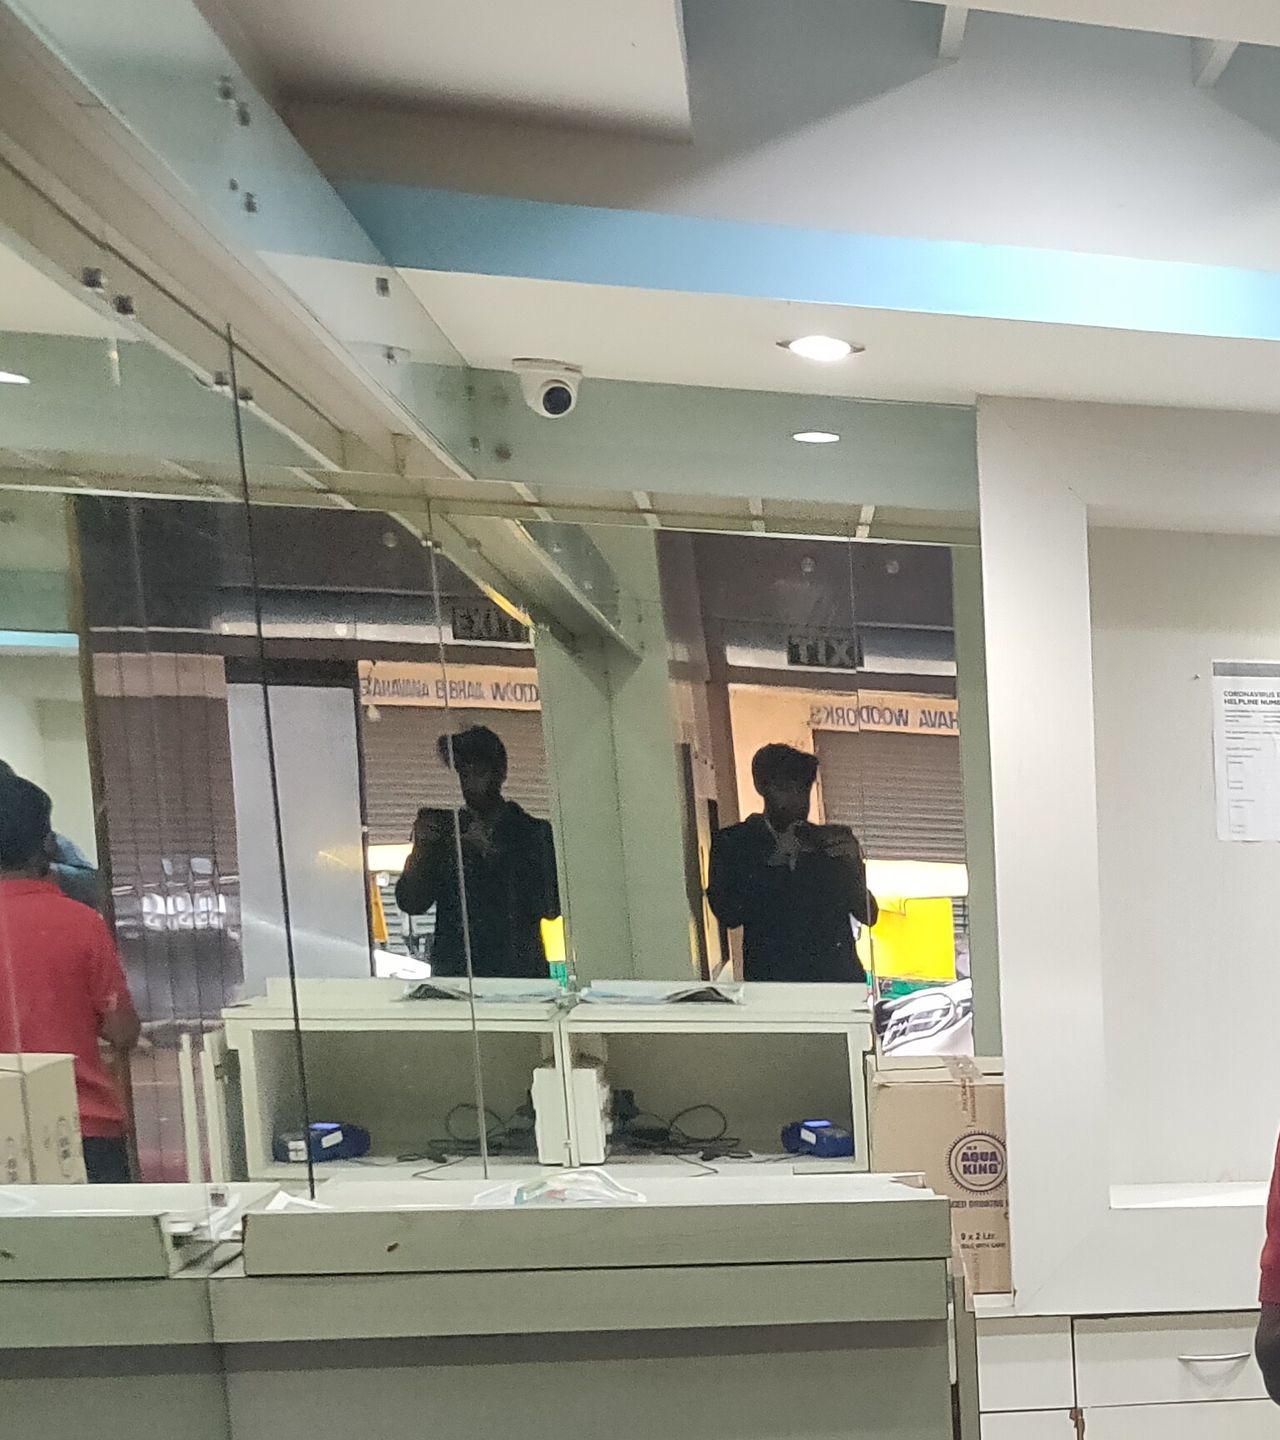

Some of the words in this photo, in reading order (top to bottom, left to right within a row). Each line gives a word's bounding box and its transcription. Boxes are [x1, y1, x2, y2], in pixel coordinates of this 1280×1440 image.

[1223, 690, 1275, 698] CORONAVIRUS
[1223, 698, 1259, 706] HELPLINE
[961, 1151, 999, 1163] AQUA
[962, 1164, 999, 1175] KING
